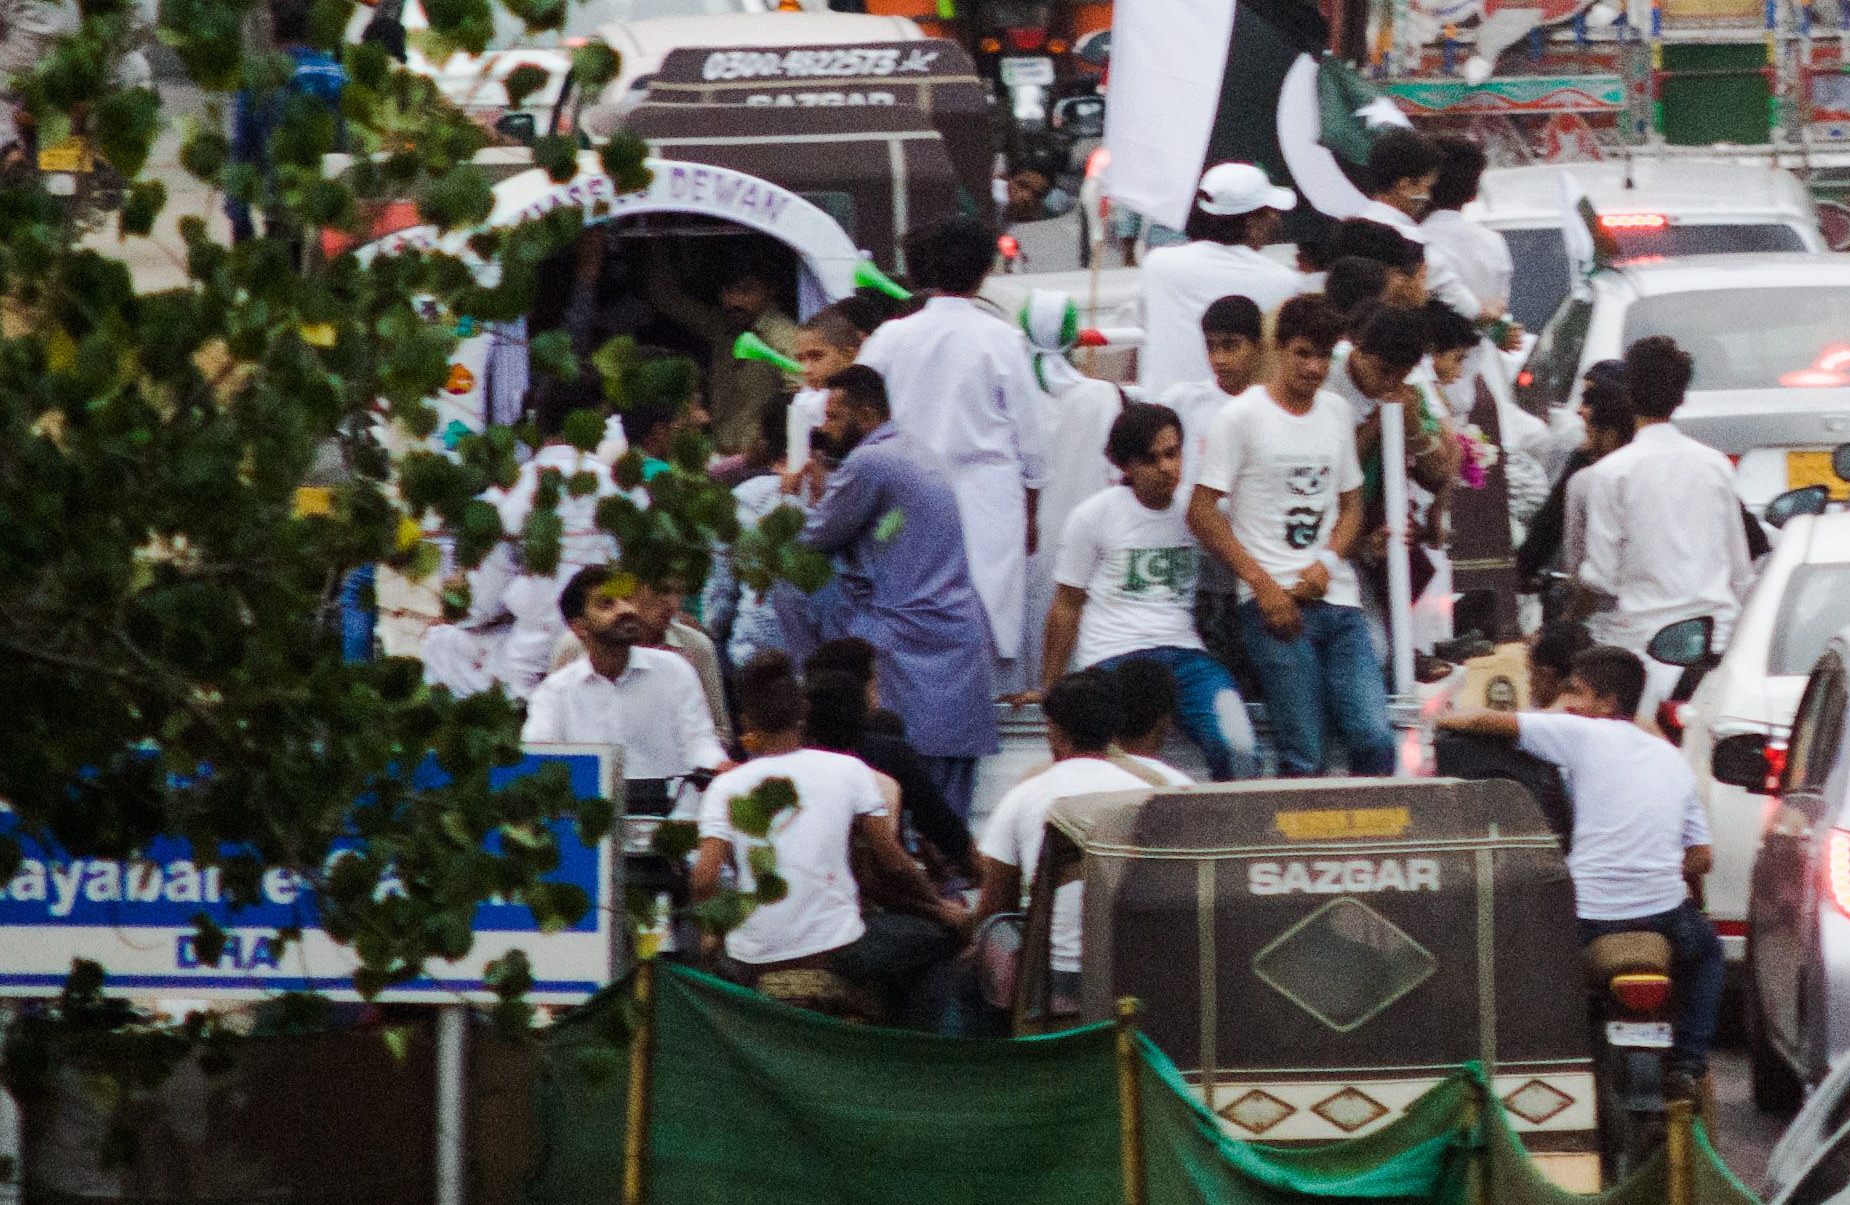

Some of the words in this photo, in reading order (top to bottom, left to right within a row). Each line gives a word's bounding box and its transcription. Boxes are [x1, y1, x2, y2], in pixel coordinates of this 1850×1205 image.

[671, 167, 787, 223] DEWAN
[1248, 857, 1440, 895] SAZGAR
[176, 935, 280, 969] DHA
